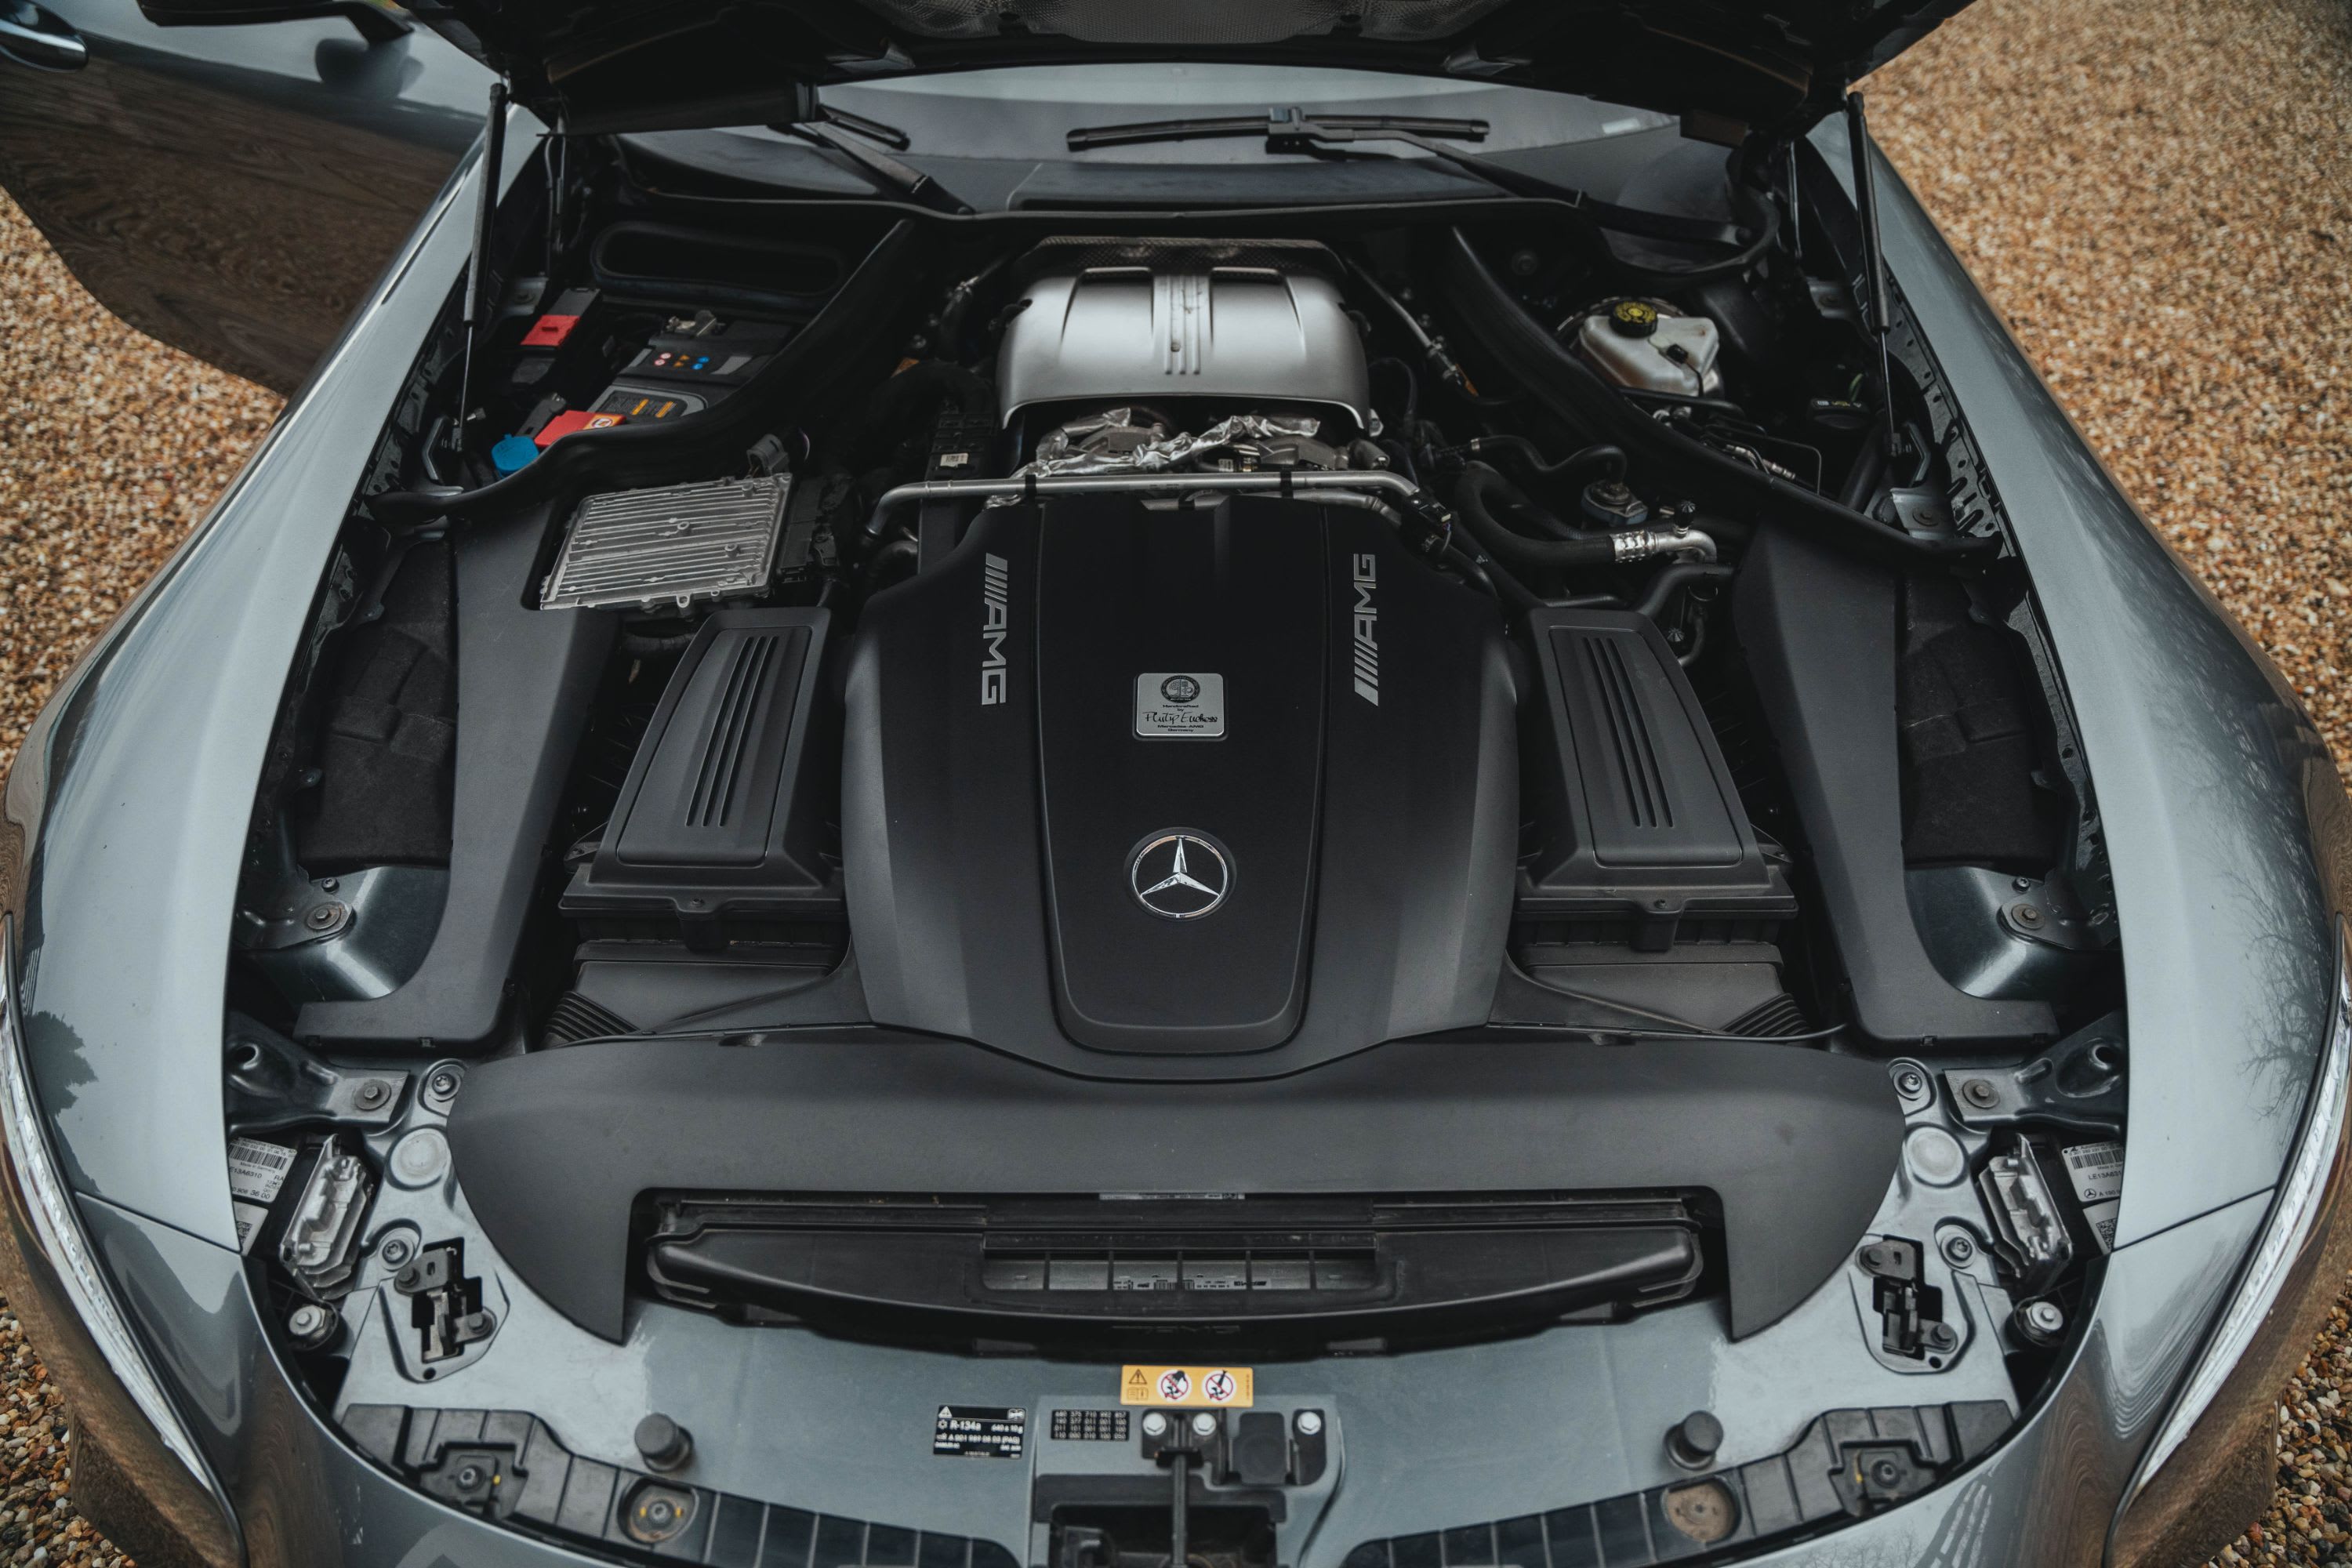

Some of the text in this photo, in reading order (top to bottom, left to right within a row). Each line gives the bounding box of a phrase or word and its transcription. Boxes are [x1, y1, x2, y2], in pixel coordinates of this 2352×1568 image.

[1353, 554, 1377, 651] AMG
[982, 597, 1007, 705] AMG
[228, 1167, 263, 1178] E13A6310
[2088, 1171, 2122, 1180] LE13A631
[949, 1420, 982, 1432] R-134a
